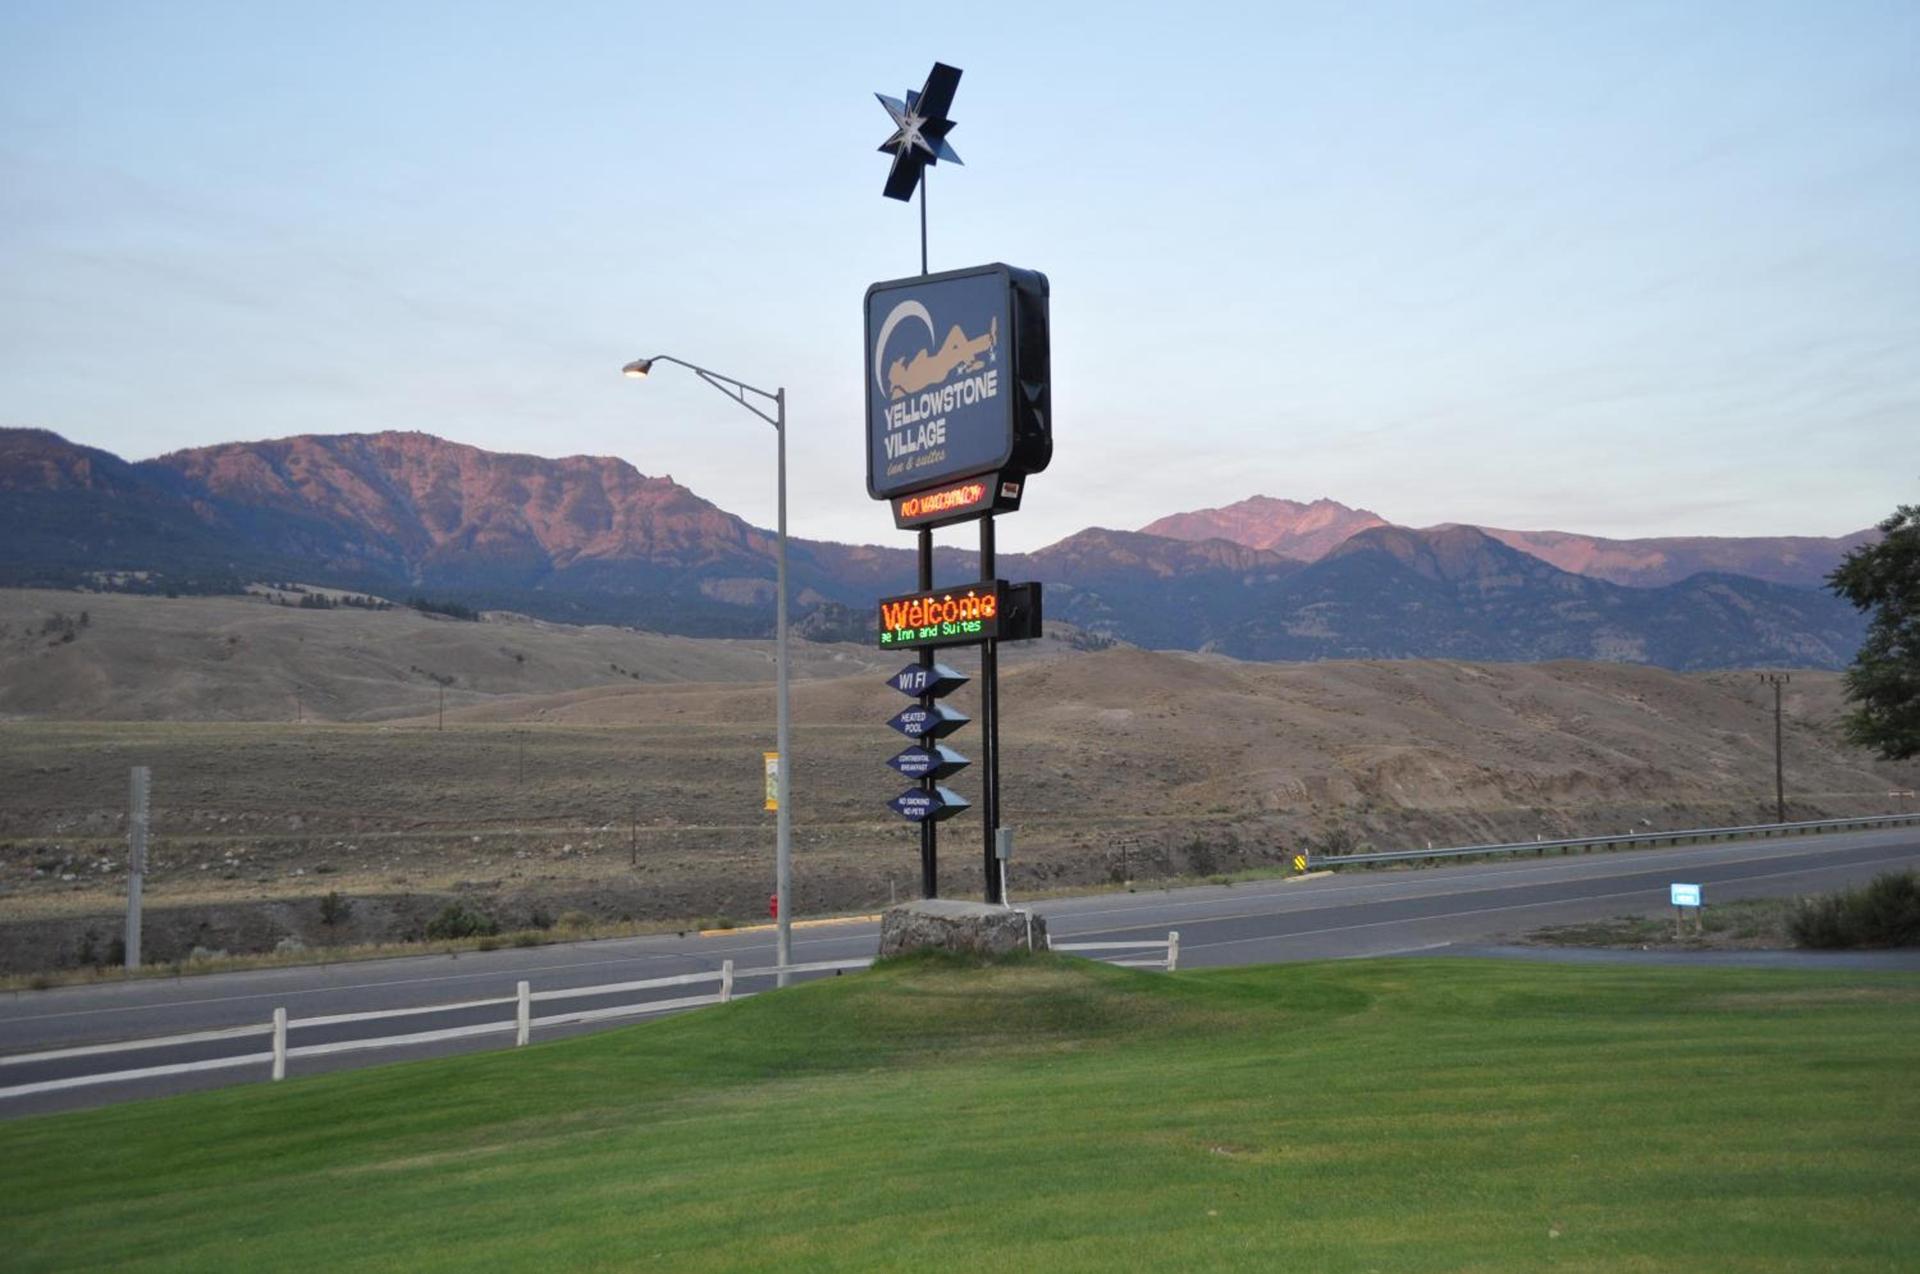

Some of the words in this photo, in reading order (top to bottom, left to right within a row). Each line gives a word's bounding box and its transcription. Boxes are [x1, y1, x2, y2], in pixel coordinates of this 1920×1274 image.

[884, 369, 997, 431] YELLOWSTONE
[884, 418, 946, 460] VILLAGE
[901, 498, 919, 517] NO
[921, 484, 984, 513] VACANCY
[882, 594, 996, 631] Welcome
[897, 628, 915, 641] Inn
[920, 624, 938, 638] and
[942, 620, 982, 635] Suites
[901, 711, 926, 722] HEATED
[905, 722, 922, 733] POOL
